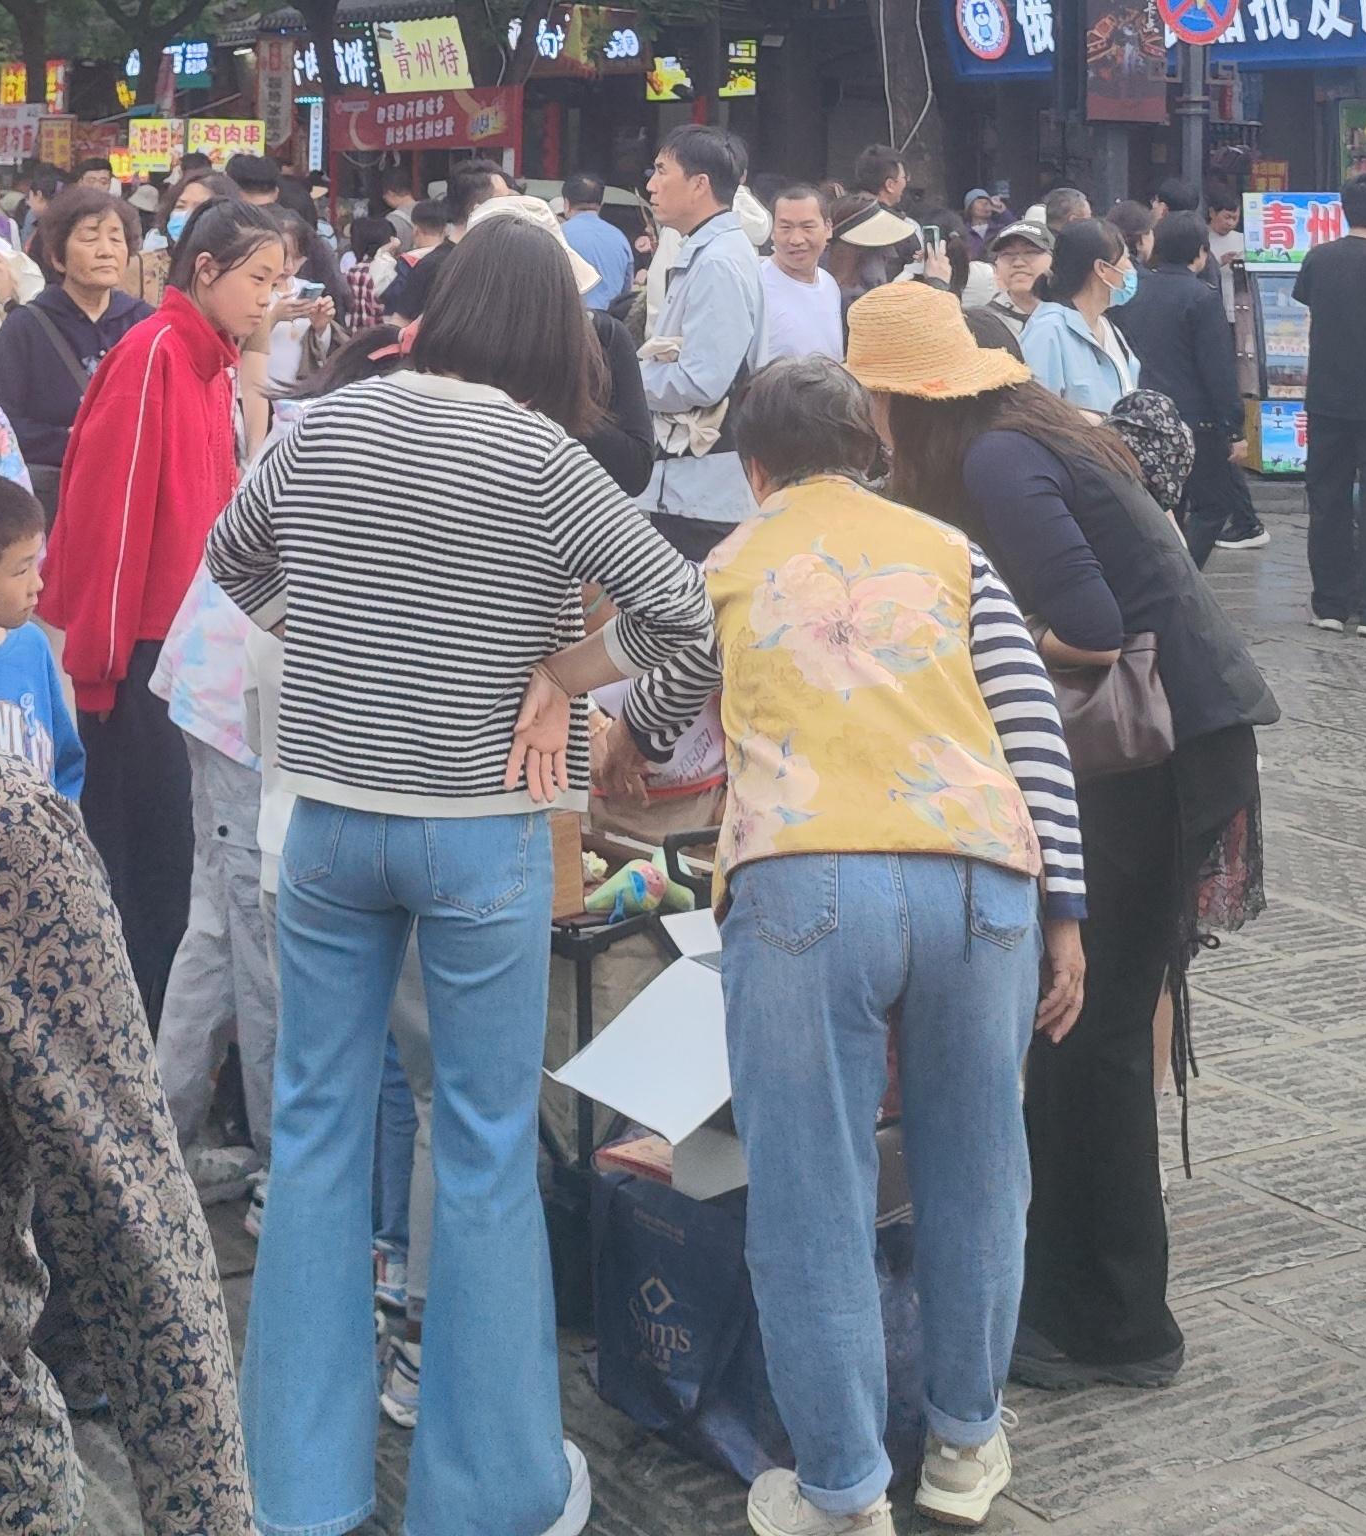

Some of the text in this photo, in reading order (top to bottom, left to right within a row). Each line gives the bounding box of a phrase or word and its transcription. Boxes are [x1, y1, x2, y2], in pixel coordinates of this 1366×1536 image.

[393, 36, 460, 81] 青州特
[203, 123, 261, 145] 鸡肉串
